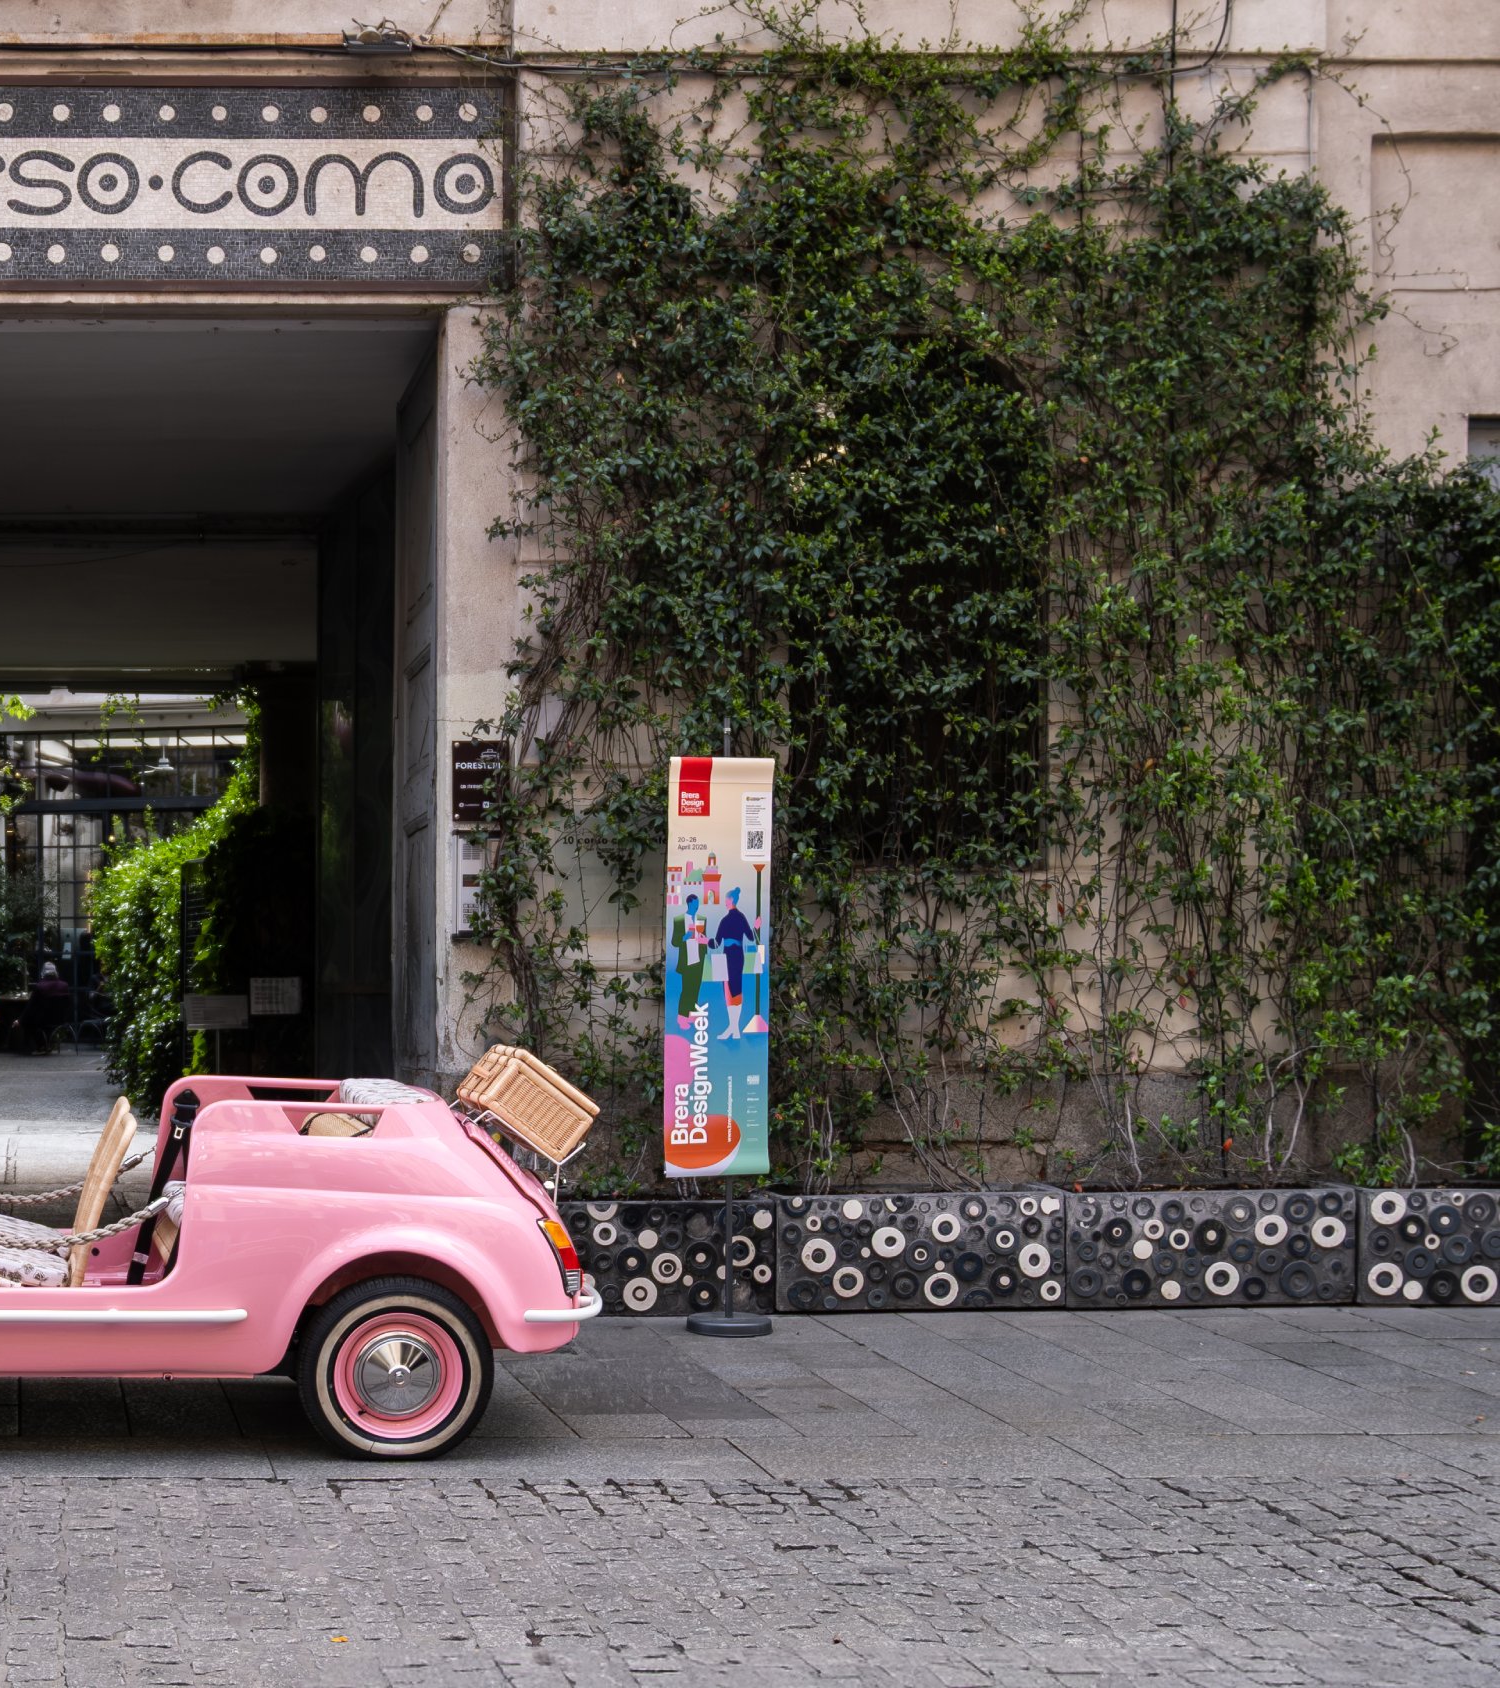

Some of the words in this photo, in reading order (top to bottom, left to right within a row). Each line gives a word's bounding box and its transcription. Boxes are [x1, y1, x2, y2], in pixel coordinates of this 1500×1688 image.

[681, 799, 705, 807] Design
[563, 836, 574, 845] 10
[670, 1083, 689, 1145] Brera
